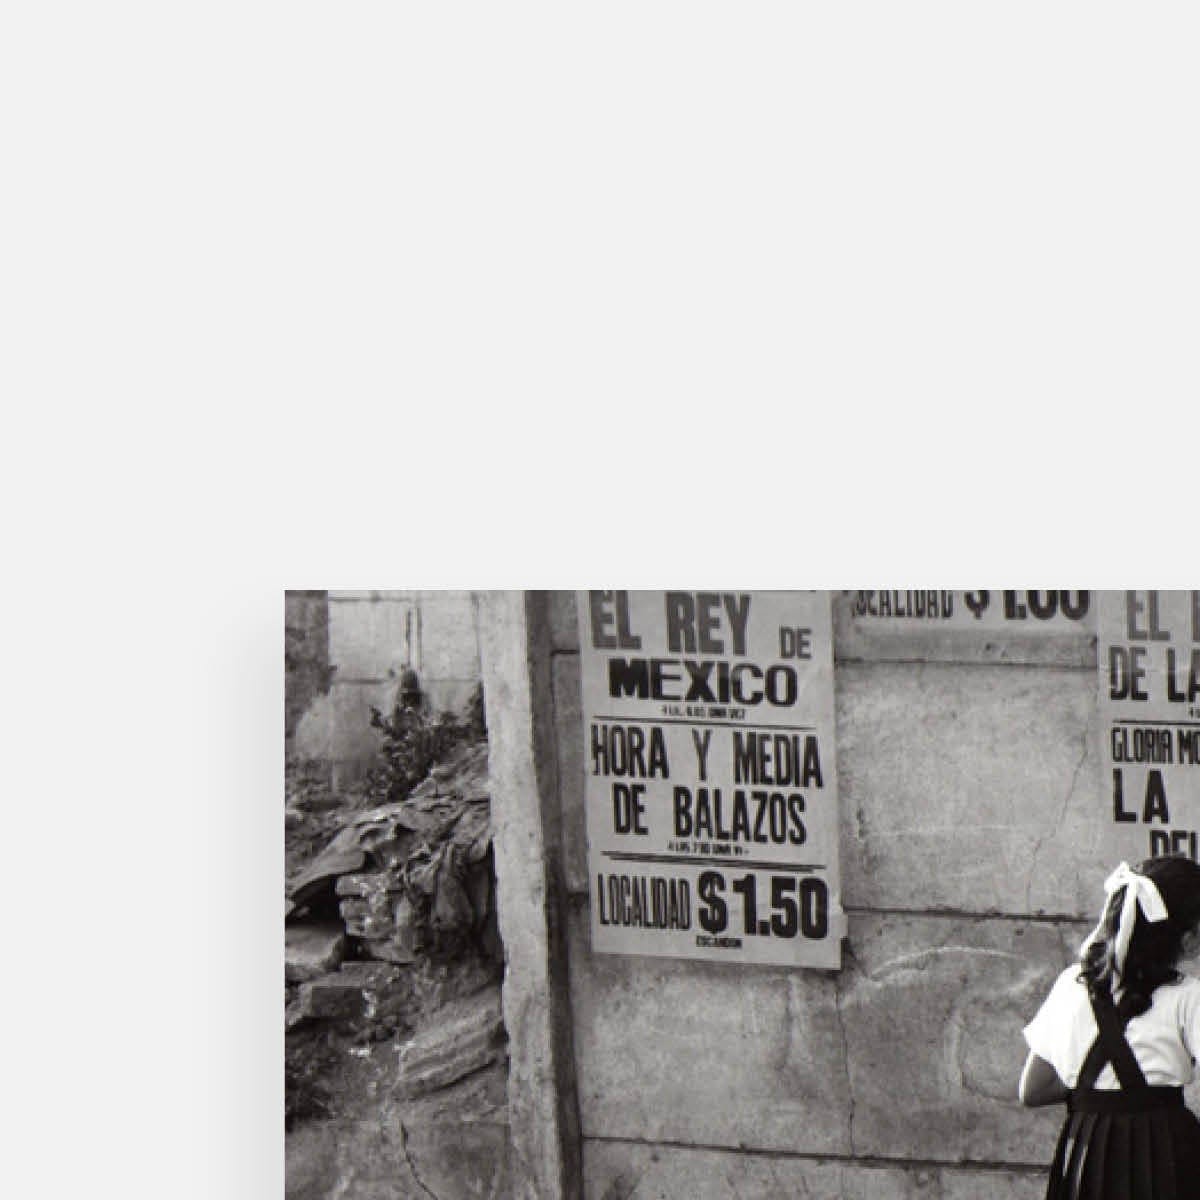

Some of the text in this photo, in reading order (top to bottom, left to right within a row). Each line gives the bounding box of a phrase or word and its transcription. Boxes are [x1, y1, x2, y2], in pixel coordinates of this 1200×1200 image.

[590, 590, 812, 659] EL REY DE
[1126, 590, 1171, 641] EL
[609, 658, 798, 707] MEXICO
[1108, 646, 1149, 700] DE
[591, 724, 823, 788] HORA Y MEDIA
[1111, 727, 1173, 763] GLORIA
[613, 782, 807, 845] DE BALAZOS
[1112, 768, 1169, 824] LA
[598, 872, 691, 930] LOCALIDAD
